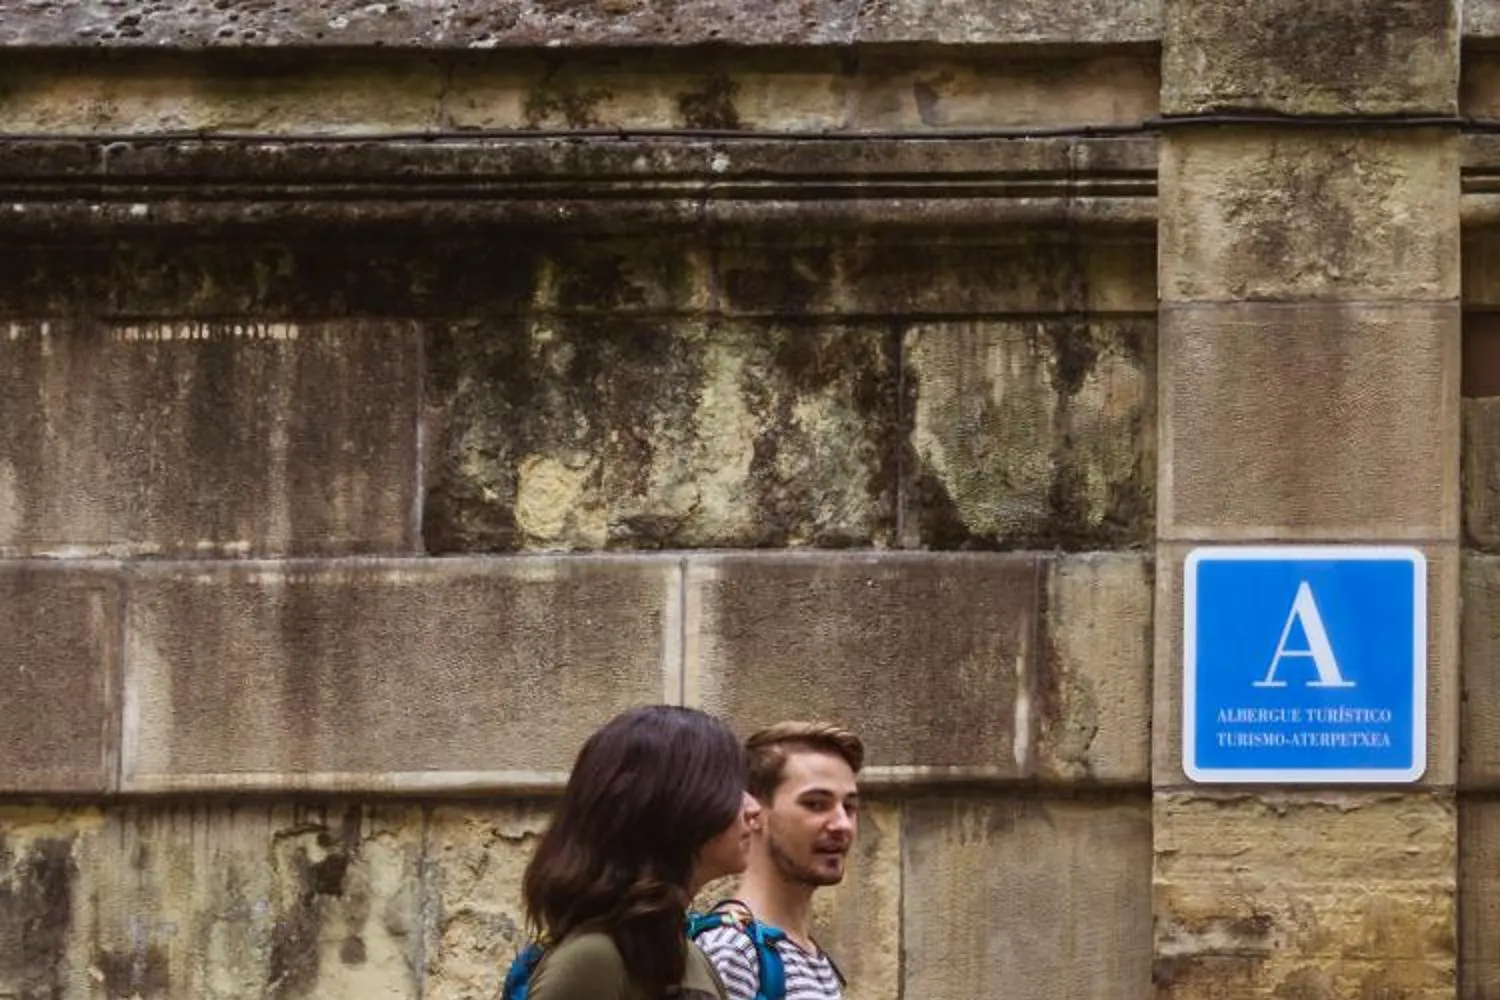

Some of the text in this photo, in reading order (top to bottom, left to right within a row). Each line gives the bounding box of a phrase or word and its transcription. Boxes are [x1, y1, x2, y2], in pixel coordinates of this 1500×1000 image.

[1252, 580, 1356, 687] A
[1216, 704, 1392, 724] ALBERGUE TURÍSTICO
[1216, 732, 1391, 748] TURISMO-ATERPETXEA
